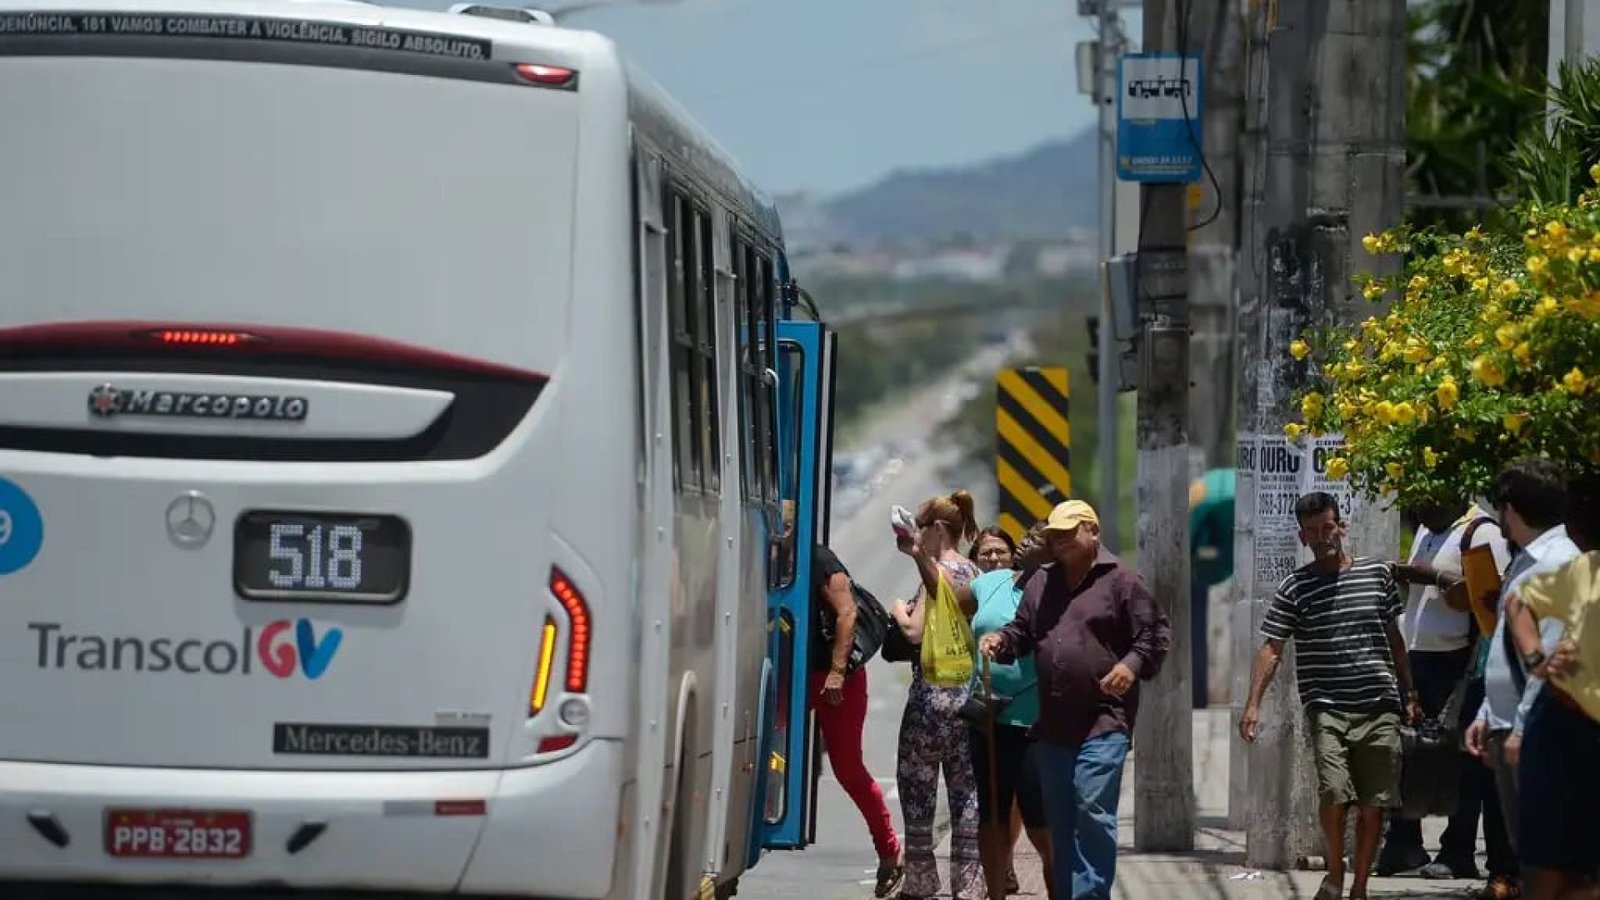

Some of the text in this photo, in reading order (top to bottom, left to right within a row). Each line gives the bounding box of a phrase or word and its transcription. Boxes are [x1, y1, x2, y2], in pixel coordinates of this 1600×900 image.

[83, 16, 107, 31] 181
[112, 17, 163, 33] VAMOS
[166, 18, 249, 35] COMBATER
[352, 31, 400, 48] SIGILO
[127, 391, 305, 418] Marcopolo
[1261, 446, 1300, 473] OURO
[269, 524, 362, 588] 518
[284, 726, 481, 756] Mercedes-Benz
